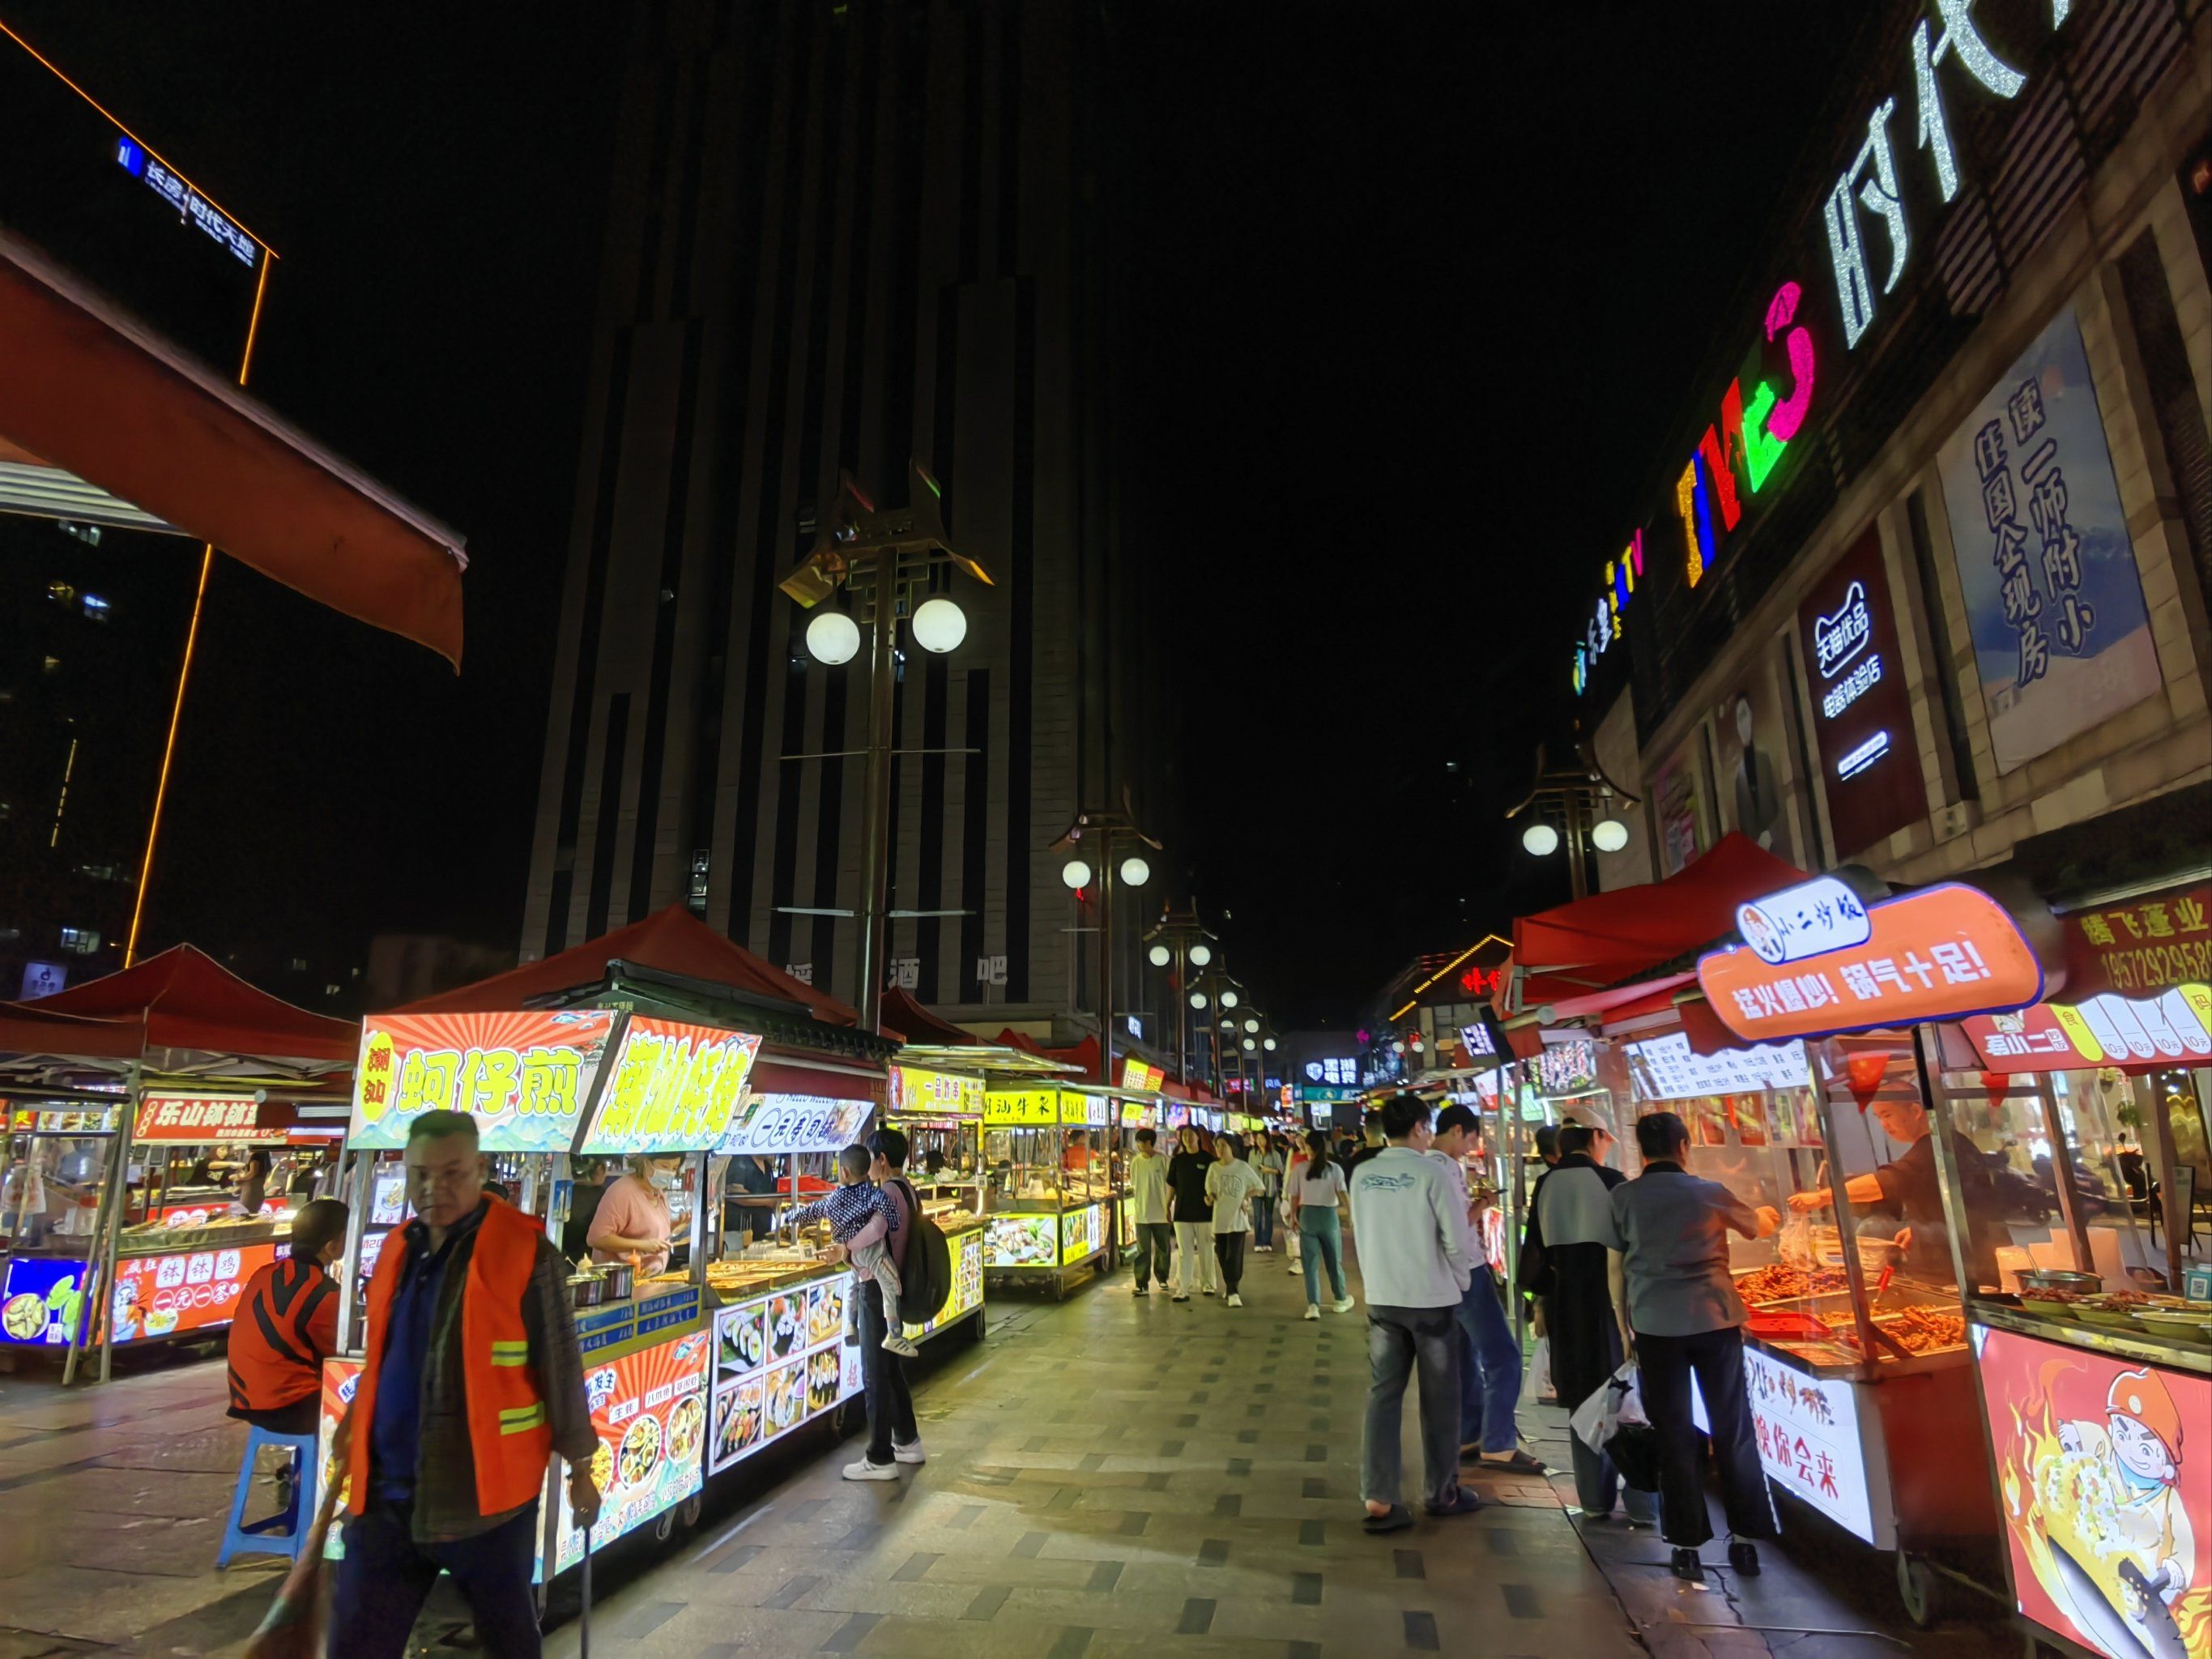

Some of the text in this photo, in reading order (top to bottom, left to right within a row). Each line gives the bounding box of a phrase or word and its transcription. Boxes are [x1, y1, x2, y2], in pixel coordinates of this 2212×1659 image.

[1825, 0, 2070, 350] 时代
[1817, 601, 1869, 670] 天猫优品
[1839, 940, 1992, 1000] 锅气十足!
[2103, 1043, 2125, 1054] 10元
[2129, 1041, 2152, 1052] 10元
[2156, 1038, 2180, 1050] 10元
[2184, 1035, 2210, 1048] 10元
[398, 1049, 582, 1115] 蚵仔煎
[160, 1249, 241, 1285] 钵钵鸡
[154, 1282, 230, 1311] 一元一签
